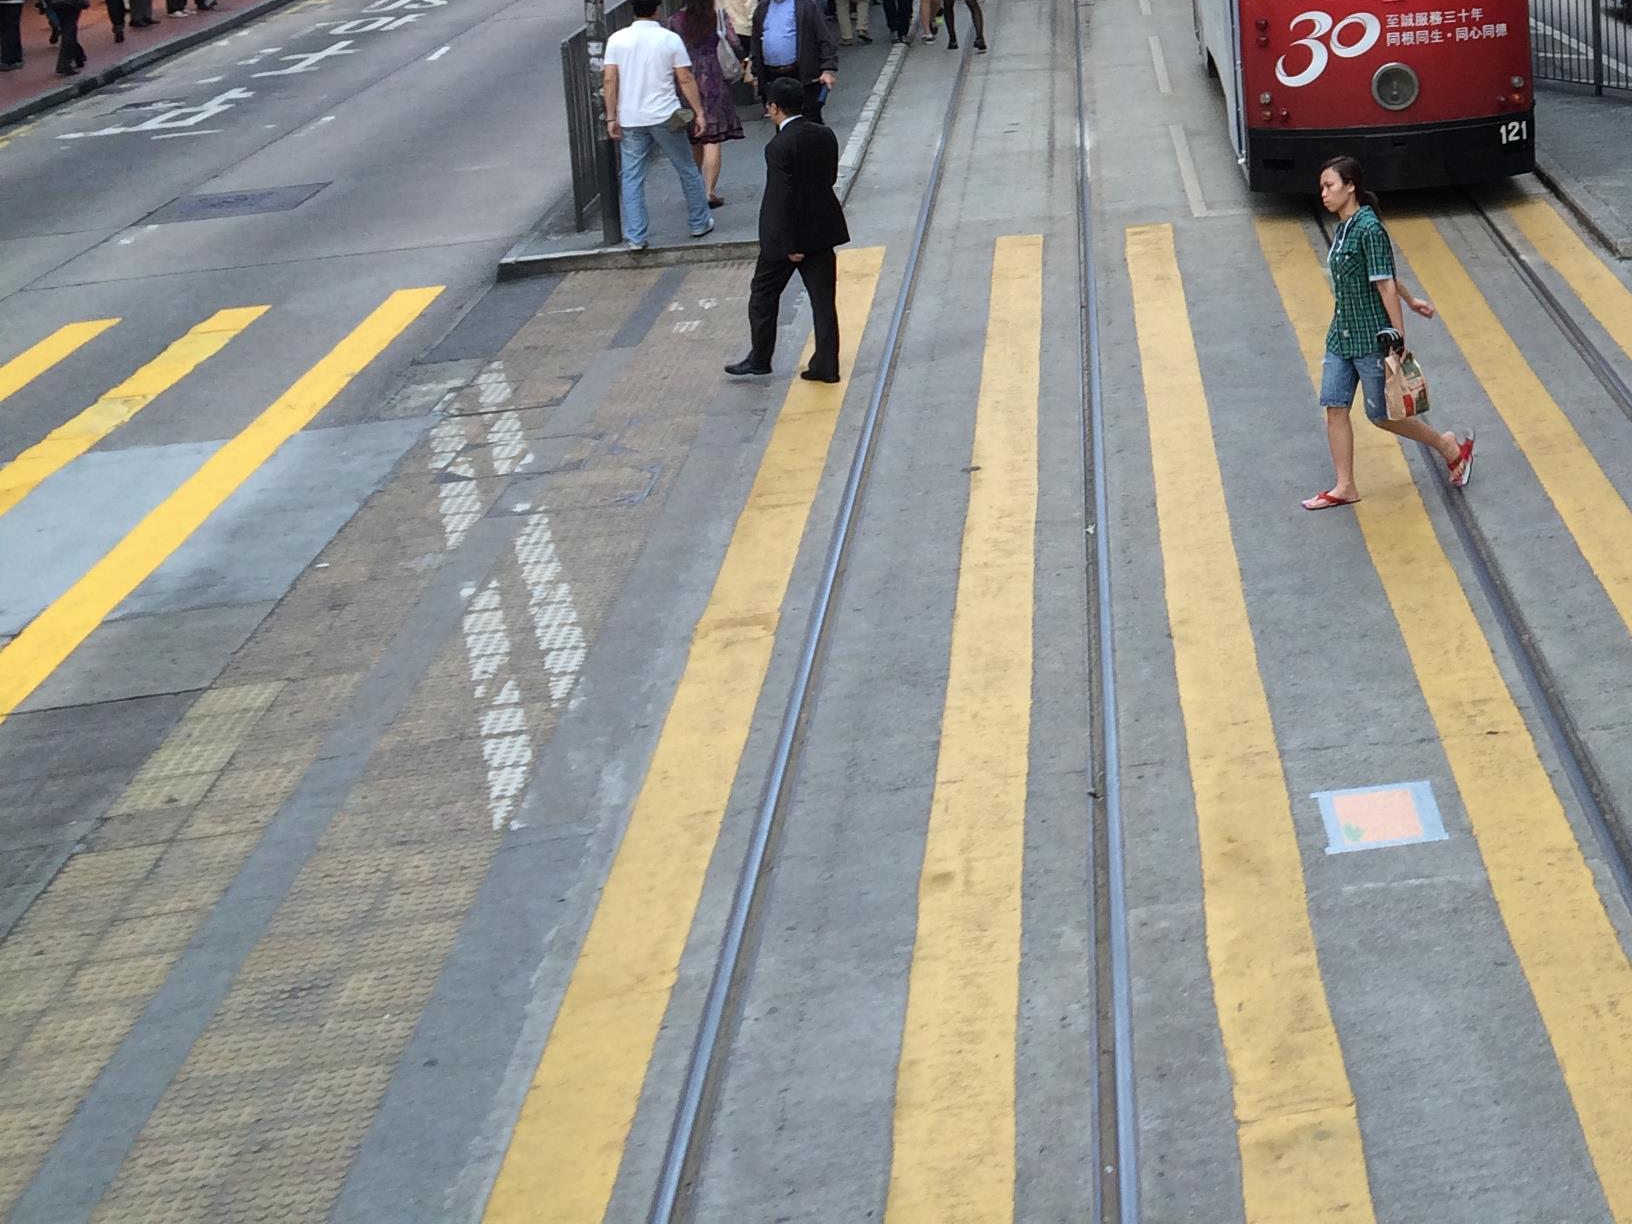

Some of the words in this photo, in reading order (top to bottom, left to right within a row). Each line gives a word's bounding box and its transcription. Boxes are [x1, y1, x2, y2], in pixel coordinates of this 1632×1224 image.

[1385, 7, 1484, 29] 至誠服務三十年
[1274, 10, 1382, 88] 30
[1499, 120, 1528, 145] 121
